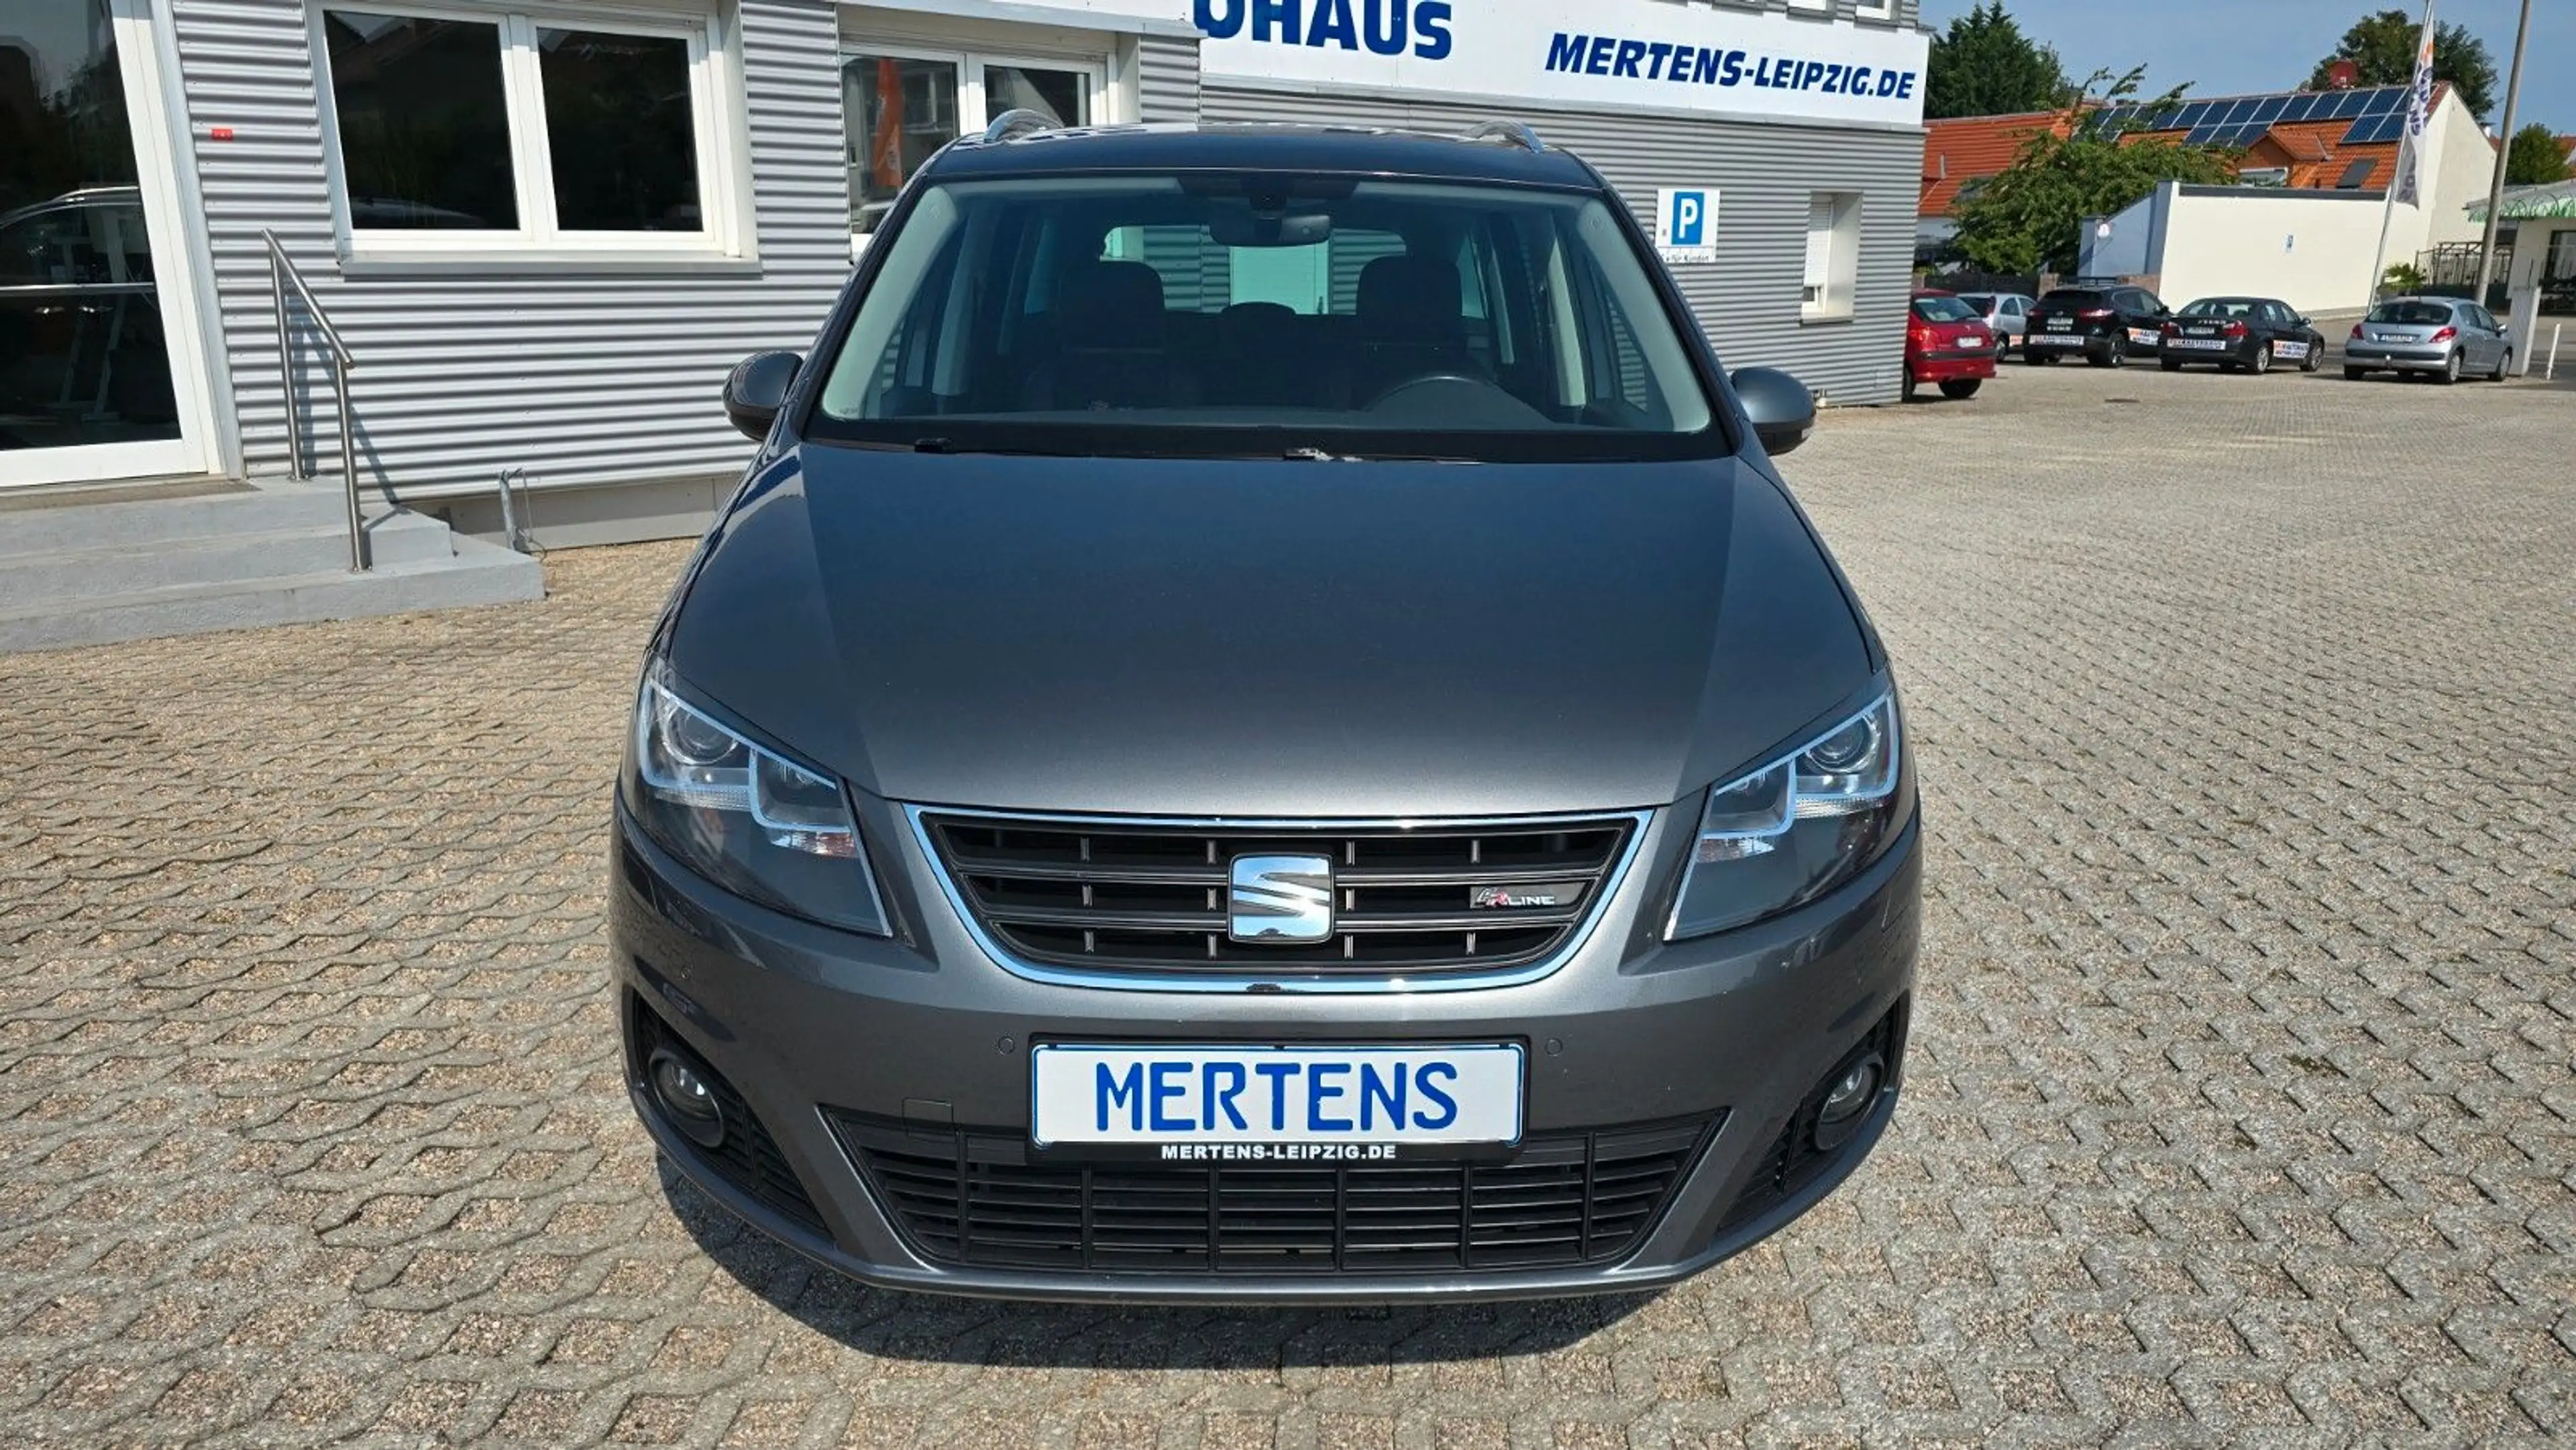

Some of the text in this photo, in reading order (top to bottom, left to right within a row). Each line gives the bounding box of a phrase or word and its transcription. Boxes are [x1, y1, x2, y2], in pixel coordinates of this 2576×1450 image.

[1545, 32, 1916, 99] MERTENS-LEIPZIG.DE
[1678, 198, 1699, 239] P
[1095, 1062, 1458, 1131] MERTENS
[1161, 1144, 1397, 1160] MERTENS-LEIPZIG.DE
